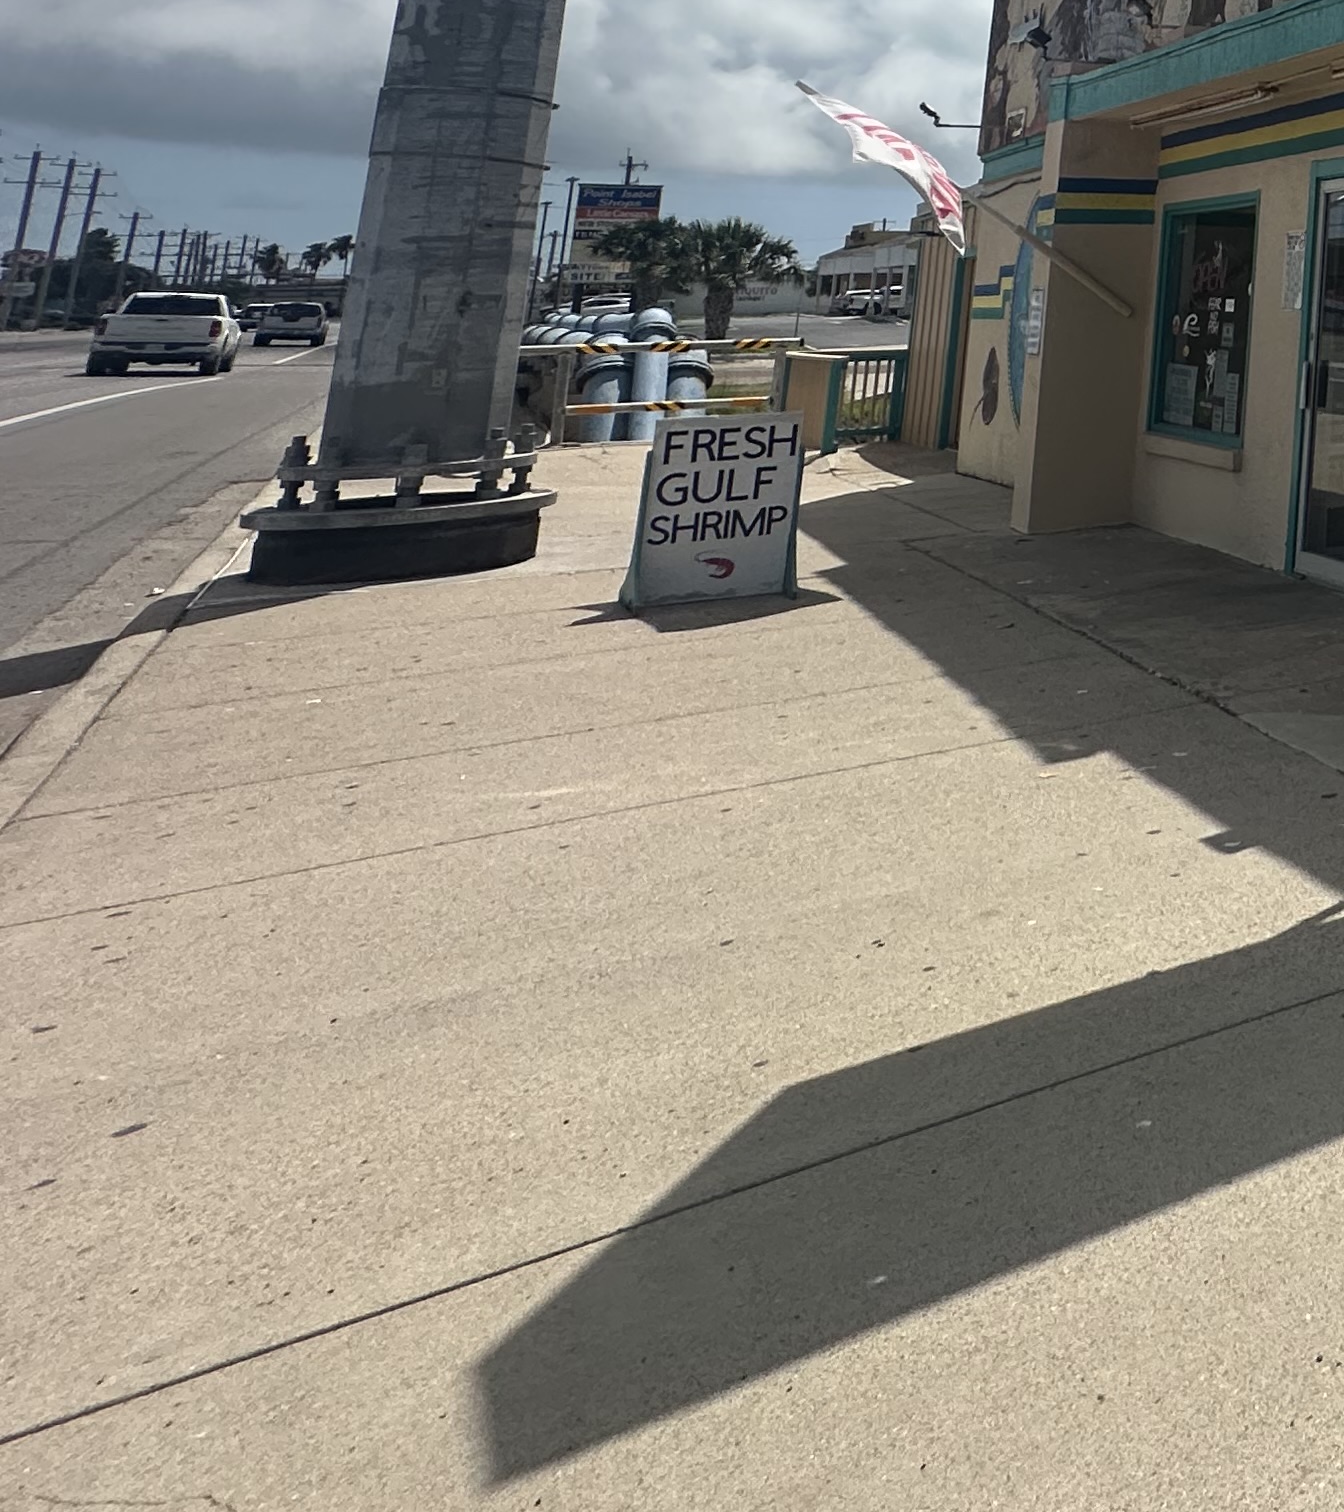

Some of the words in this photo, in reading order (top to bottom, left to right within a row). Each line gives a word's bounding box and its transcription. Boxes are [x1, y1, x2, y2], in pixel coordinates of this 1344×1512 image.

[662, 423, 799, 465] FRESH
[655, 465, 778, 507] GULF
[646, 504, 788, 546] SHRIMP
